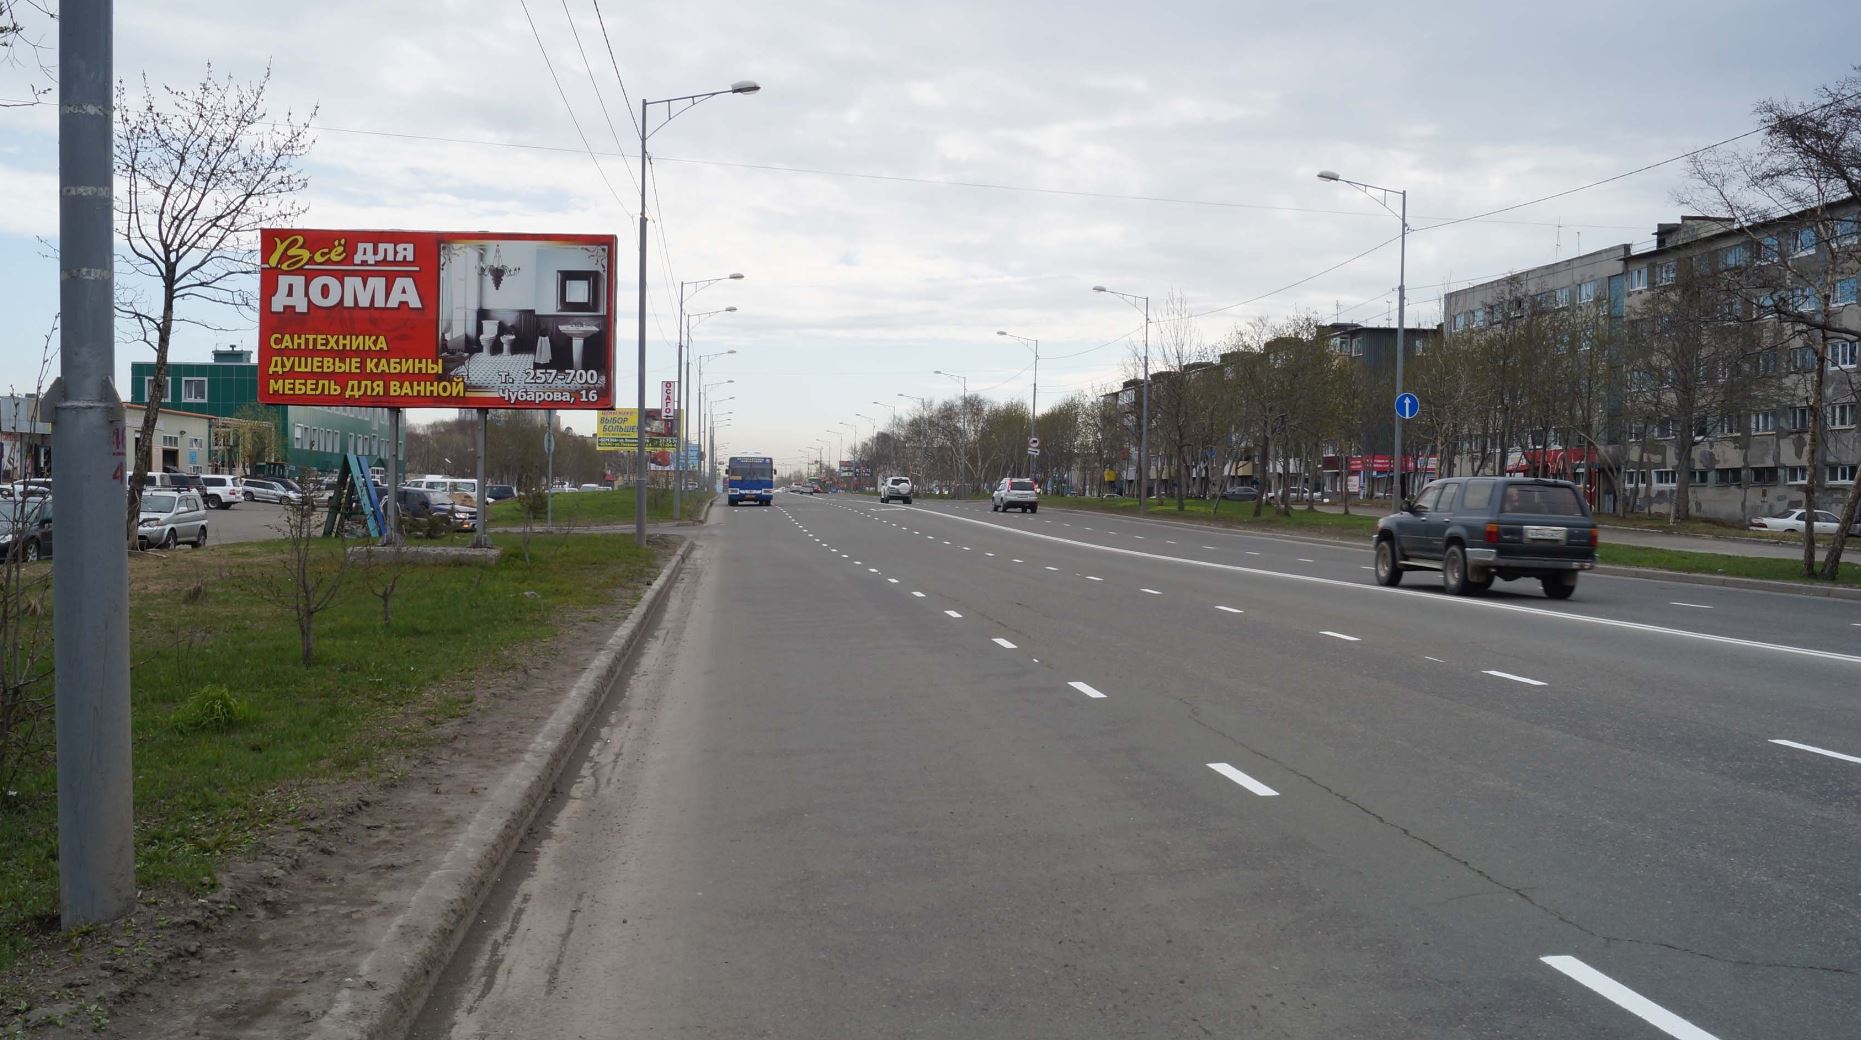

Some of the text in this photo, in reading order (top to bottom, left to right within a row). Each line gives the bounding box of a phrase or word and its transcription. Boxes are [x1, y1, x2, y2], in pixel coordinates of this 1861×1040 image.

[271, 275, 423, 313] ДОМА
[270, 333, 388, 352] САНТЕХНИКА
[268, 356, 444, 376] ДУШЕВЫЕ КАБИНЫ
[524, 369, 599, 385] 257-700
[269, 377, 465, 398] МЕБЕЛЬ ДЛЯ ВАННОЙ
[498, 388, 598, 404] Чубарова, 16
[664, 382, 672, 414] ОСАГО
[600, 416, 628, 425] ВЫБОР
